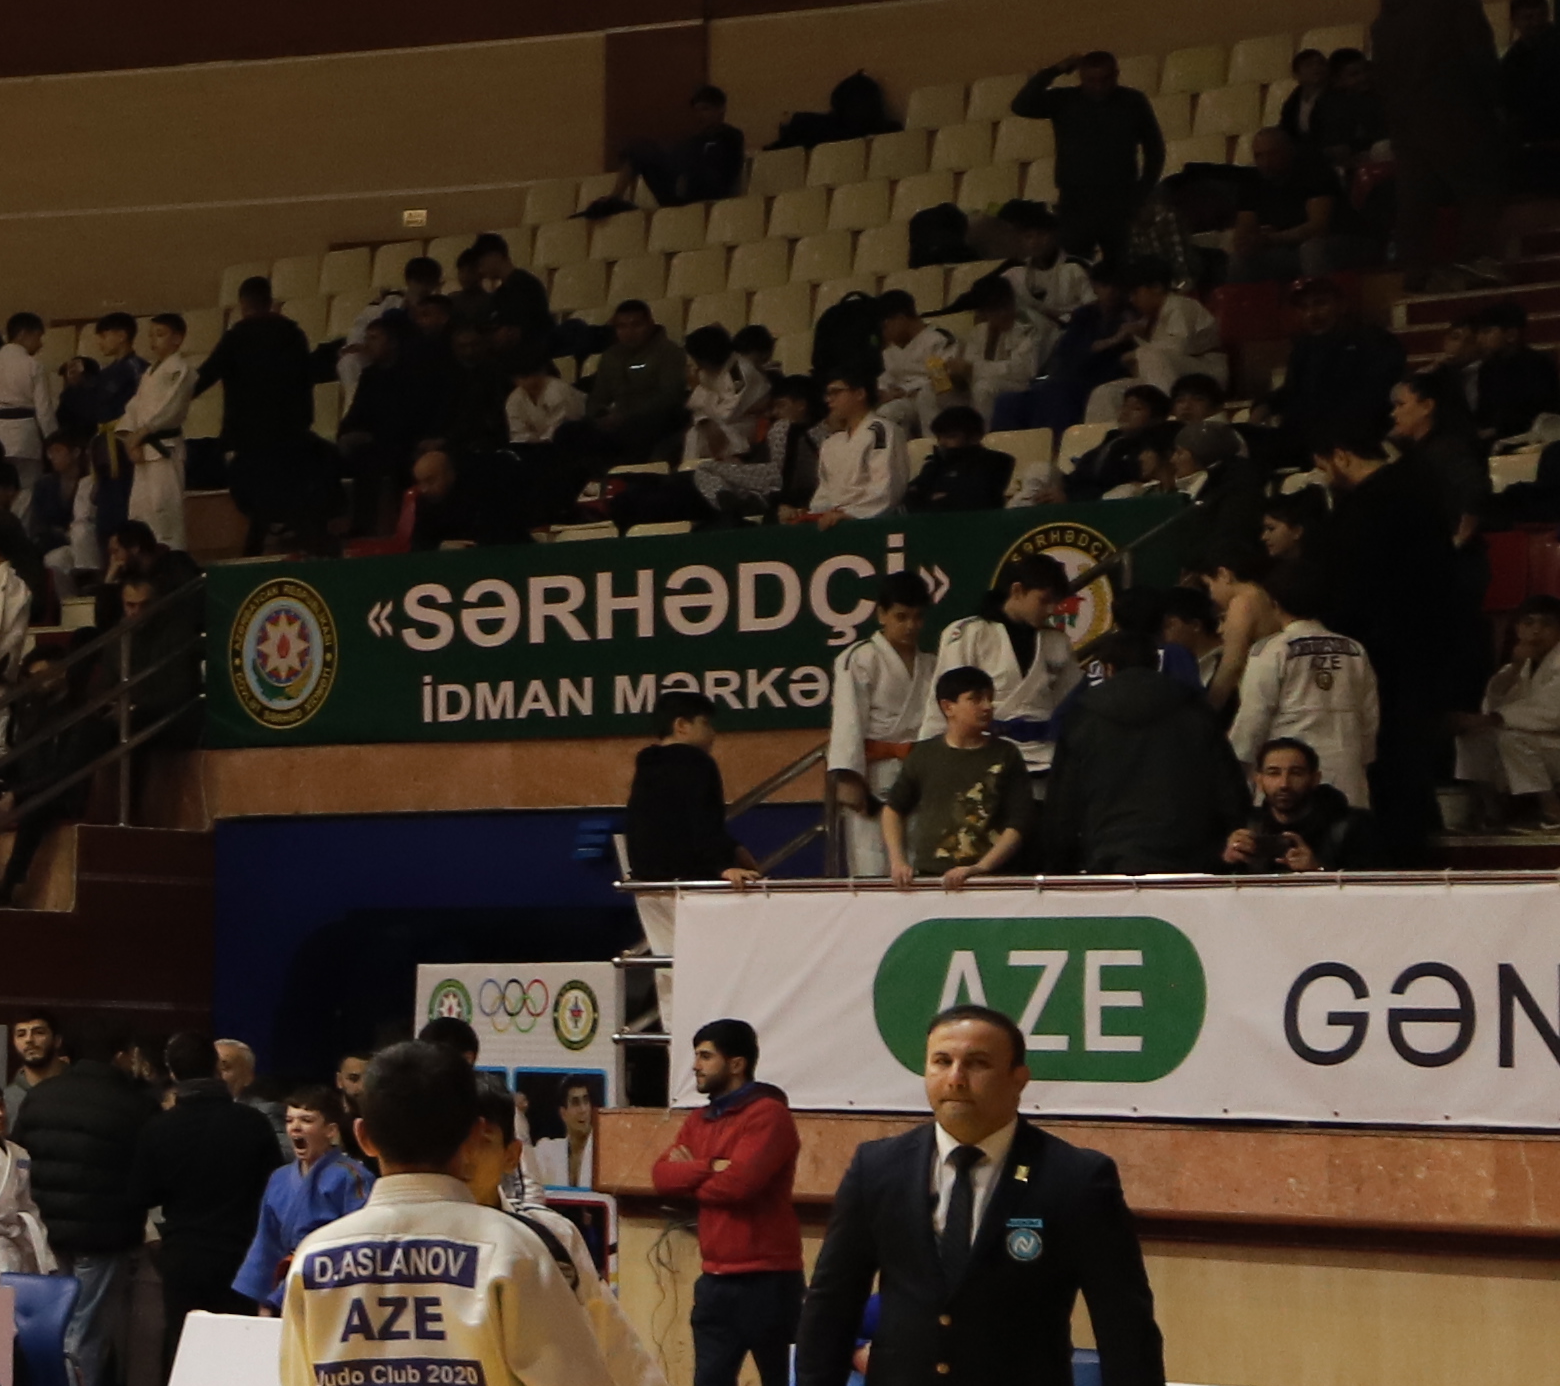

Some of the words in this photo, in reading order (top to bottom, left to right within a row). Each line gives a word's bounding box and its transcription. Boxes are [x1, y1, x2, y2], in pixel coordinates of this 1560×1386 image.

[422, 675, 593, 723] İDMAN
[938, 949, 1145, 1053] AZE
[313, 1246, 467, 1283] D.ASLANOV
[340, 1296, 447, 1342] AZE
[371, 1364, 421, 1385] Club
[426, 1364, 479, 1386] 2020
